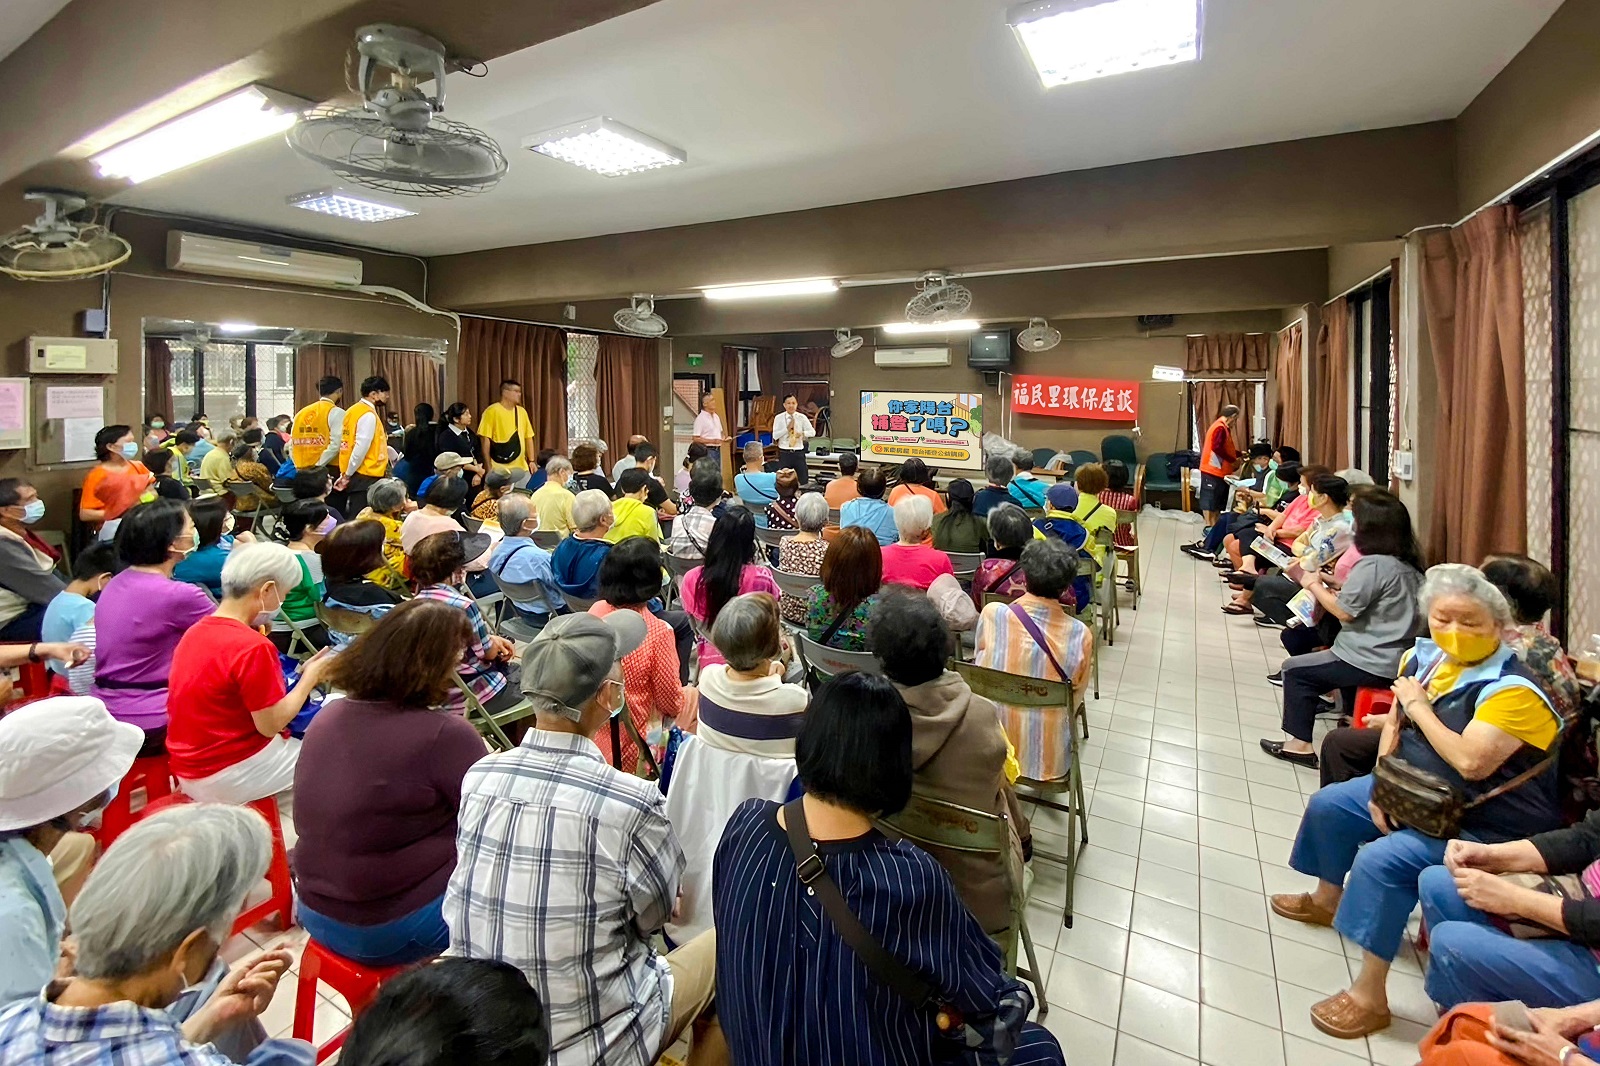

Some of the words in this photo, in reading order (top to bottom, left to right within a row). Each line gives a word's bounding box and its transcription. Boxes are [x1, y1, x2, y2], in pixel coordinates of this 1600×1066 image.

[887, 399, 955, 416] 你家陽台
[1013, 382, 1135, 413] 福民里環保座談
